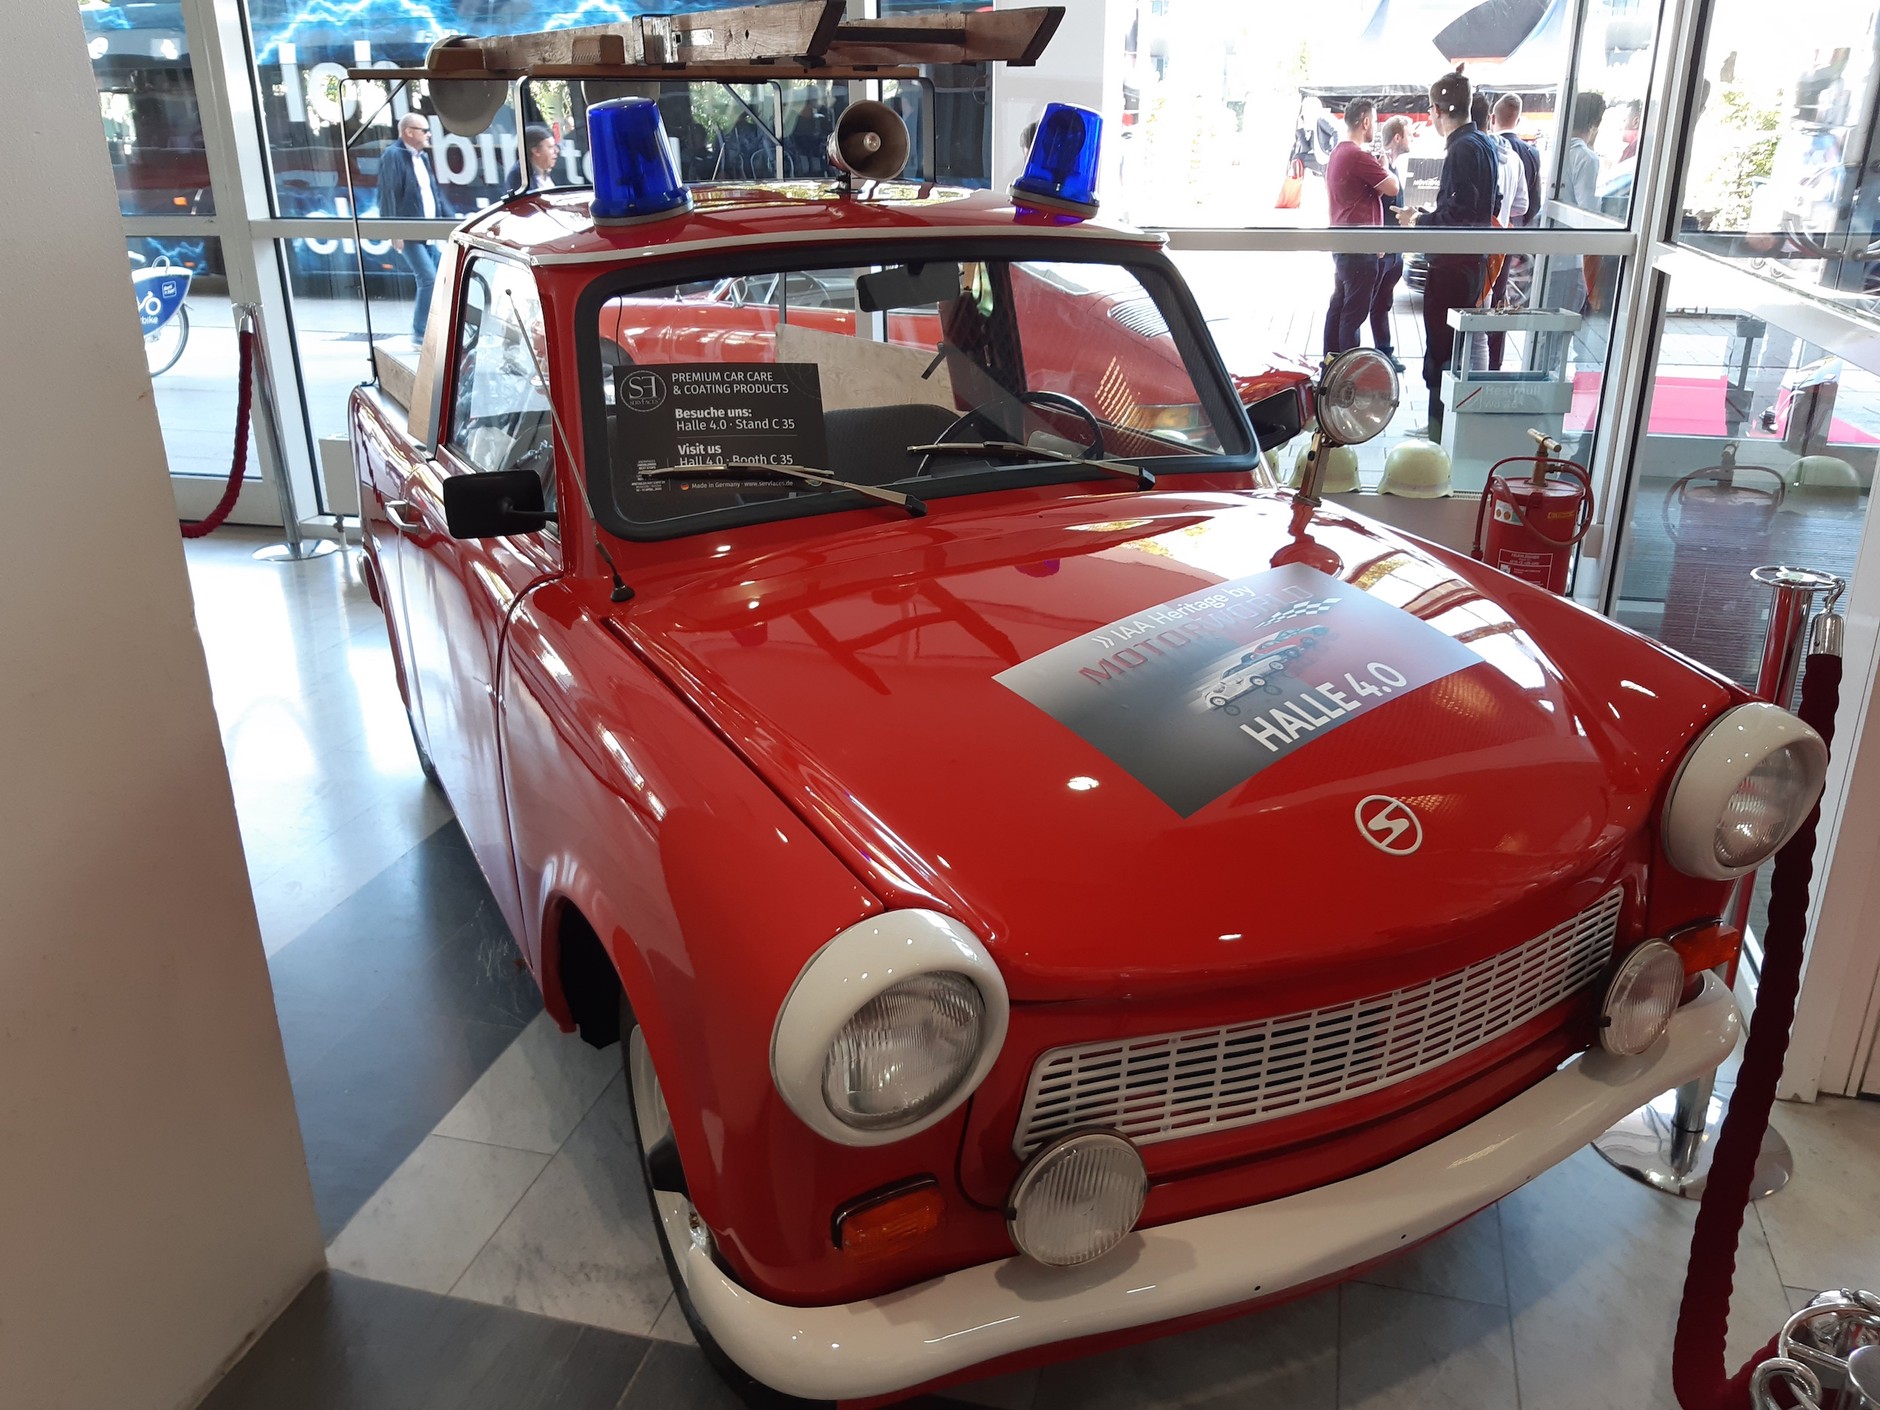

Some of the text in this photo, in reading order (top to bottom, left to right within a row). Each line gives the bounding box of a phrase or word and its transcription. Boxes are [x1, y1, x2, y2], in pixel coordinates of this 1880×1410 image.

[671, 371, 774, 383] PREMIUM CAR CARE
[673, 383, 789, 395] & COATING PRODUCTS
[675, 406, 753, 419] Besuche uns:
[676, 417, 795, 431] Halle 4.0 Stand C 35
[677, 442, 722, 455] Visit us
[679, 453, 794, 466] Hall 4.0 Booth C 35
[715, 481, 741, 490] Germany
[743, 479, 794, 488] www.servfaces.de
[1110, 584, 1256, 641] IAA Heritage by
[1078, 584, 1314, 686] MOTORWORLD
[1239, 661, 1408, 752] HALLE 4.0
